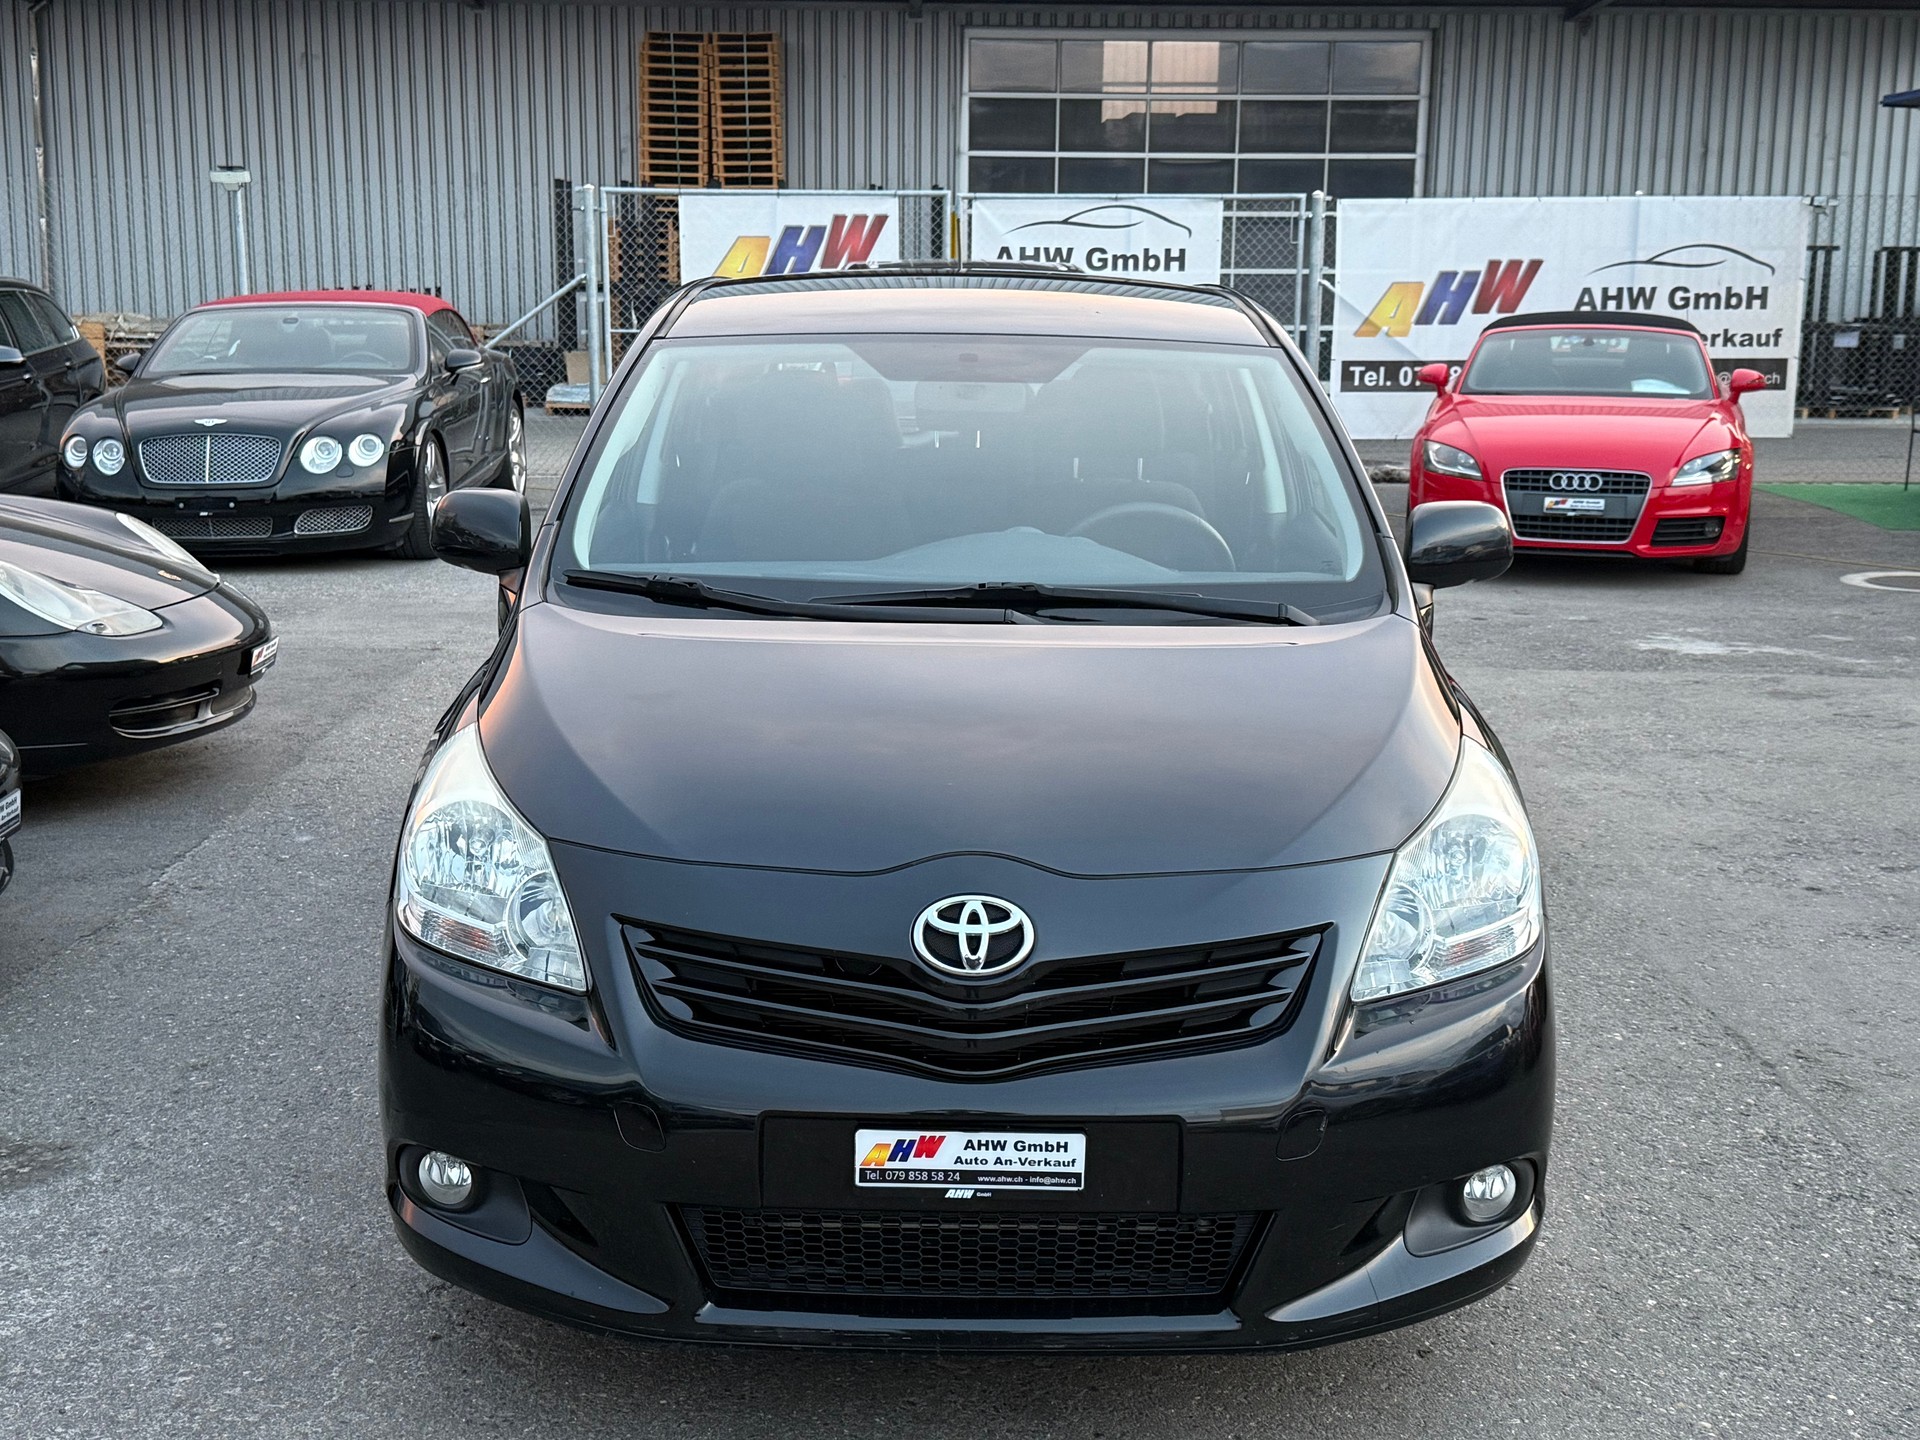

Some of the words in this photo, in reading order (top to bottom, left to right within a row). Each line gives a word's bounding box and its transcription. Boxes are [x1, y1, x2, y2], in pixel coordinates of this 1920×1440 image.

[712, 213, 889, 279] AHW
[1085, 247, 1187, 272] GmbH
[1353, 258, 1544, 338] AHW
[1573, 286, 1658, 312] AHW
[1667, 285, 1770, 311] GmbH
[1349, 366, 1391, 387] Tel.
[860, 1135, 946, 1166] AHW
[963, 1139, 1008, 1152] AHW
[1013, 1140, 1069, 1153] GmbH
[953, 1155, 989, 1166] Auto
[993, 1156, 1077, 1168] An-Verkauf
[865, 1170, 883, 1180] Tel.
[885, 1171, 906, 1180] 079
[908, 1171, 929, 1181] 858
[931, 1171, 945, 1181] 58
[947, 1172, 961, 1181] 24
[977, 1175, 1024, 1183] www.ahw.ch
[1029, 1176, 1077, 1185] info@ahw.ch
[944, 1189, 975, 1199] AHW
